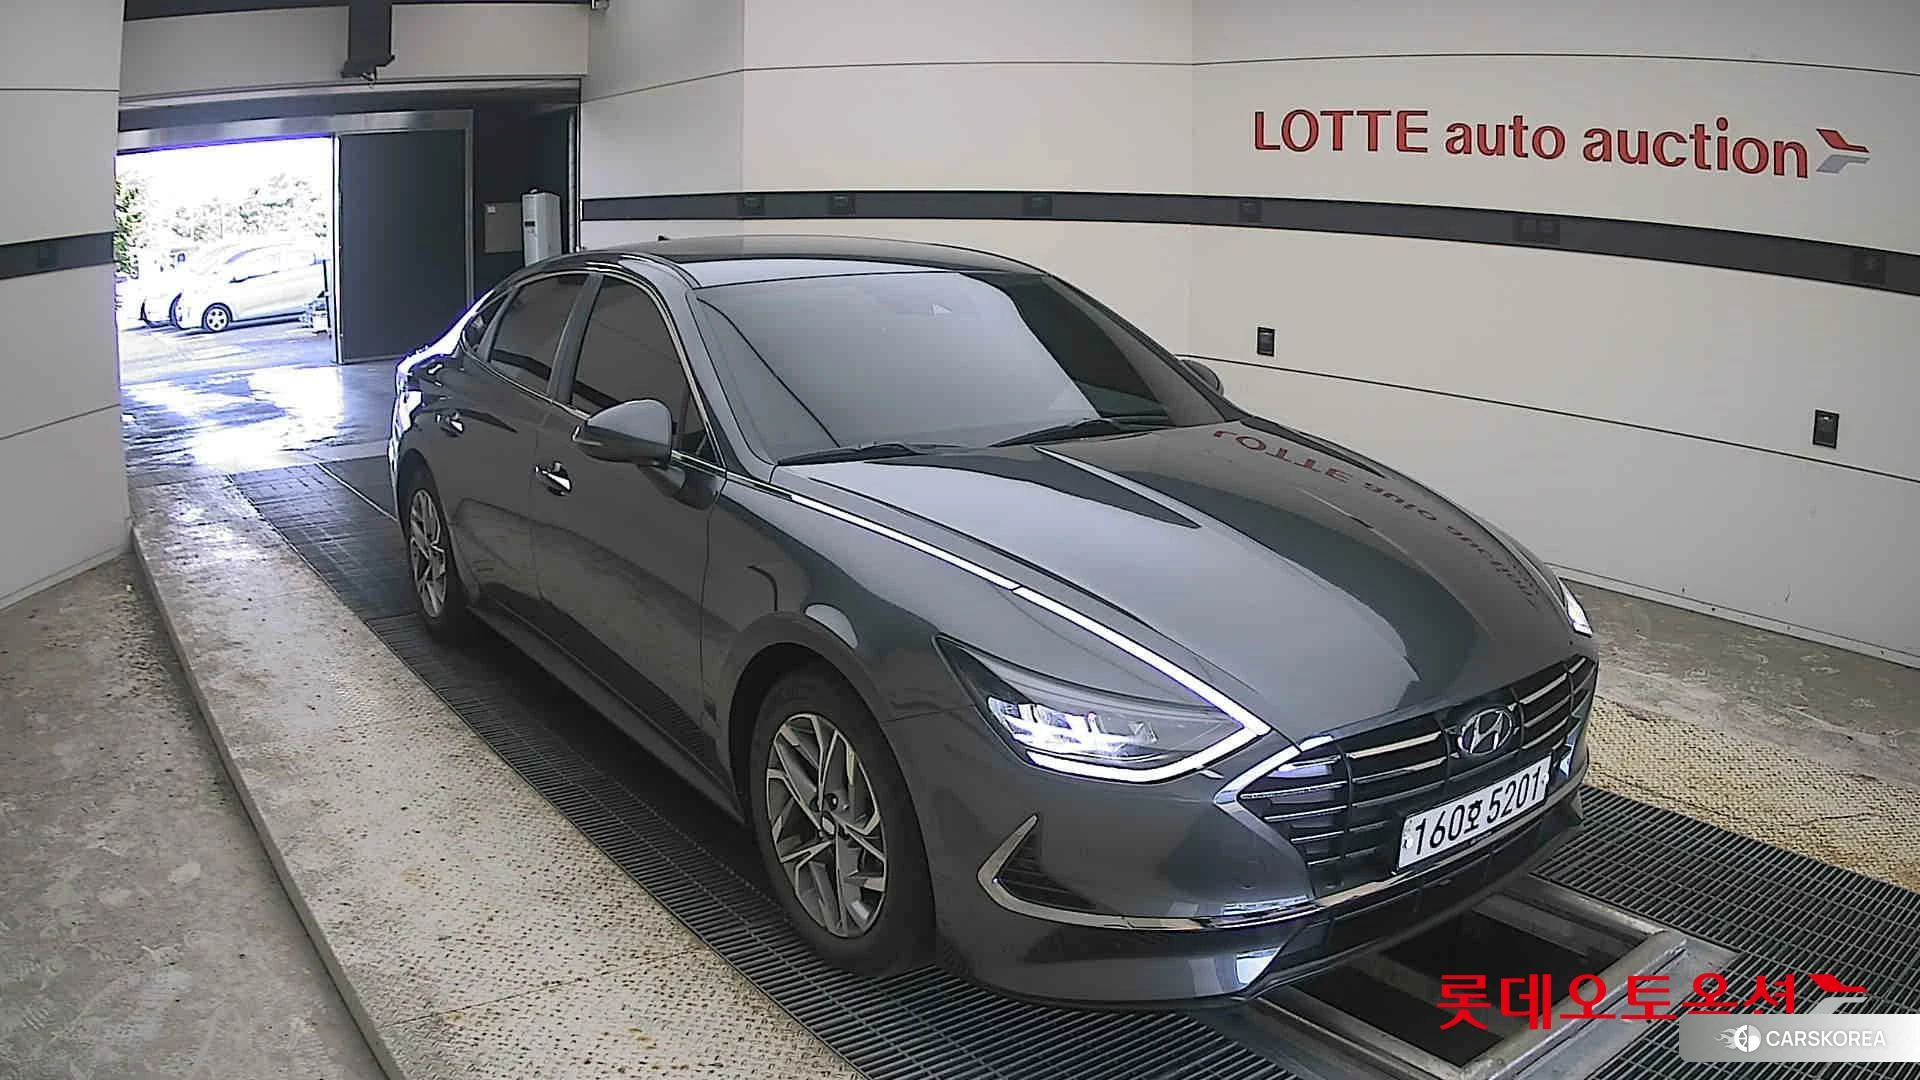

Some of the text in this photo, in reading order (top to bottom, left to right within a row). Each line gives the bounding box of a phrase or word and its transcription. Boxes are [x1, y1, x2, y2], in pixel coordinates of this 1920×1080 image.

[1254, 110, 1809, 178] LOTTE auto auction
[1487, 766, 1542, 824] 5201
